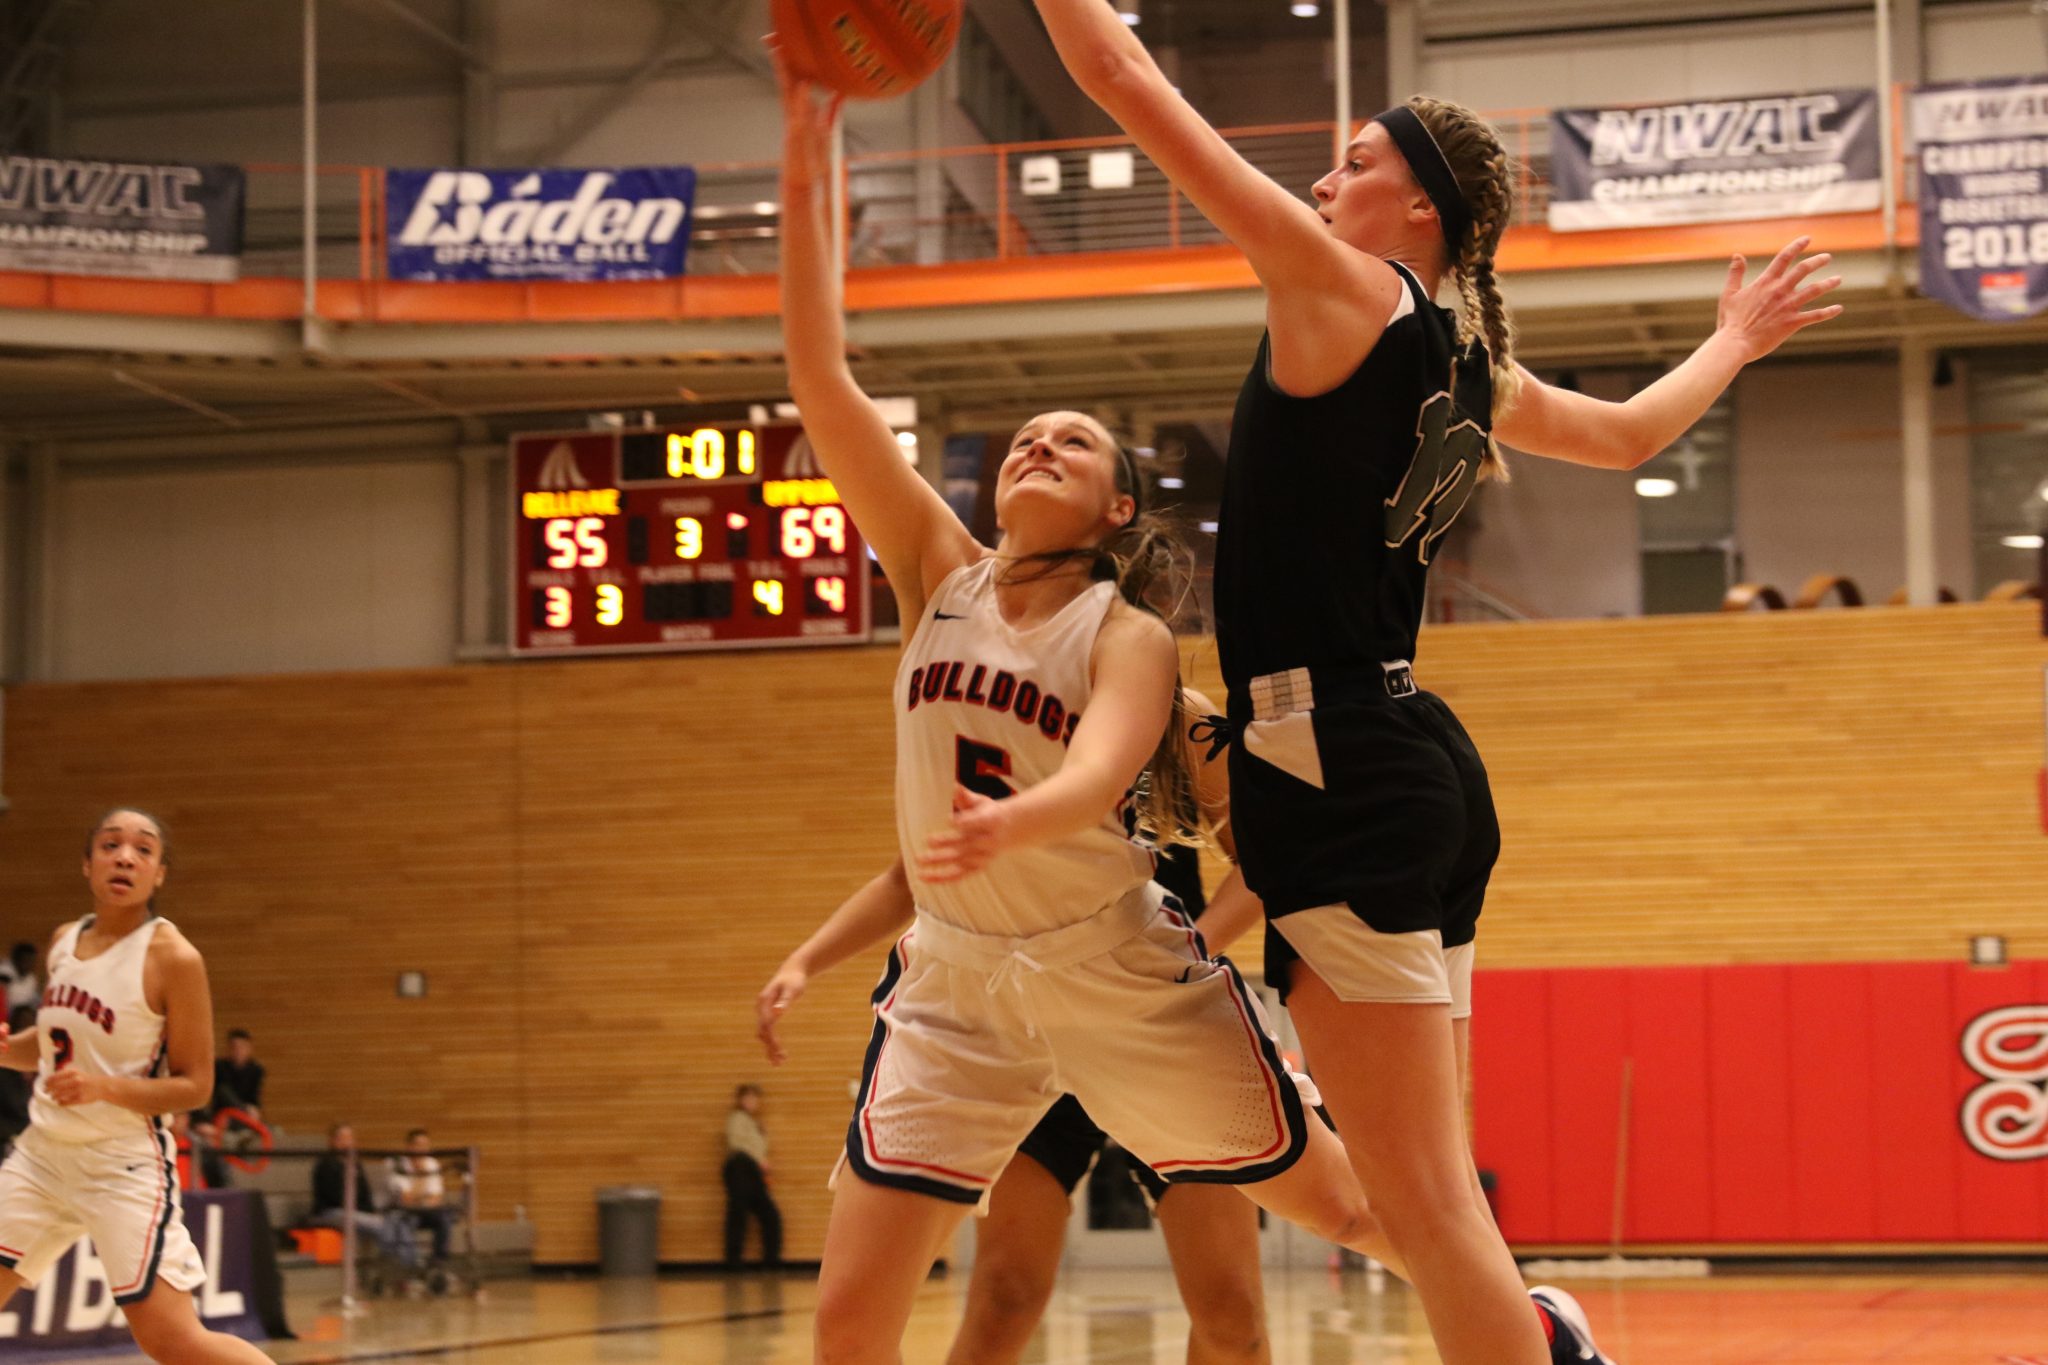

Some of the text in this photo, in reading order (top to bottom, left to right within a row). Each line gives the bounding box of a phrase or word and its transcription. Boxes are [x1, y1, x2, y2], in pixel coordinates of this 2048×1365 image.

[1592, 94, 1841, 165] NWAC
[1936, 94, 2048, 123] NWA
[1592, 161, 1847, 201] CHAMPIONSHIP
[1944, 221, 2048, 270] 2018
[545, 518, 608, 569] 55
[675, 517, 703, 559] 3
[781, 506, 845, 558] 69
[545, 586, 573, 627] 3
[596, 583, 624, 626] 3
[753, 579, 783, 616] 4
[815, 576, 845, 612] 4
[955, 733, 1018, 802] 5
